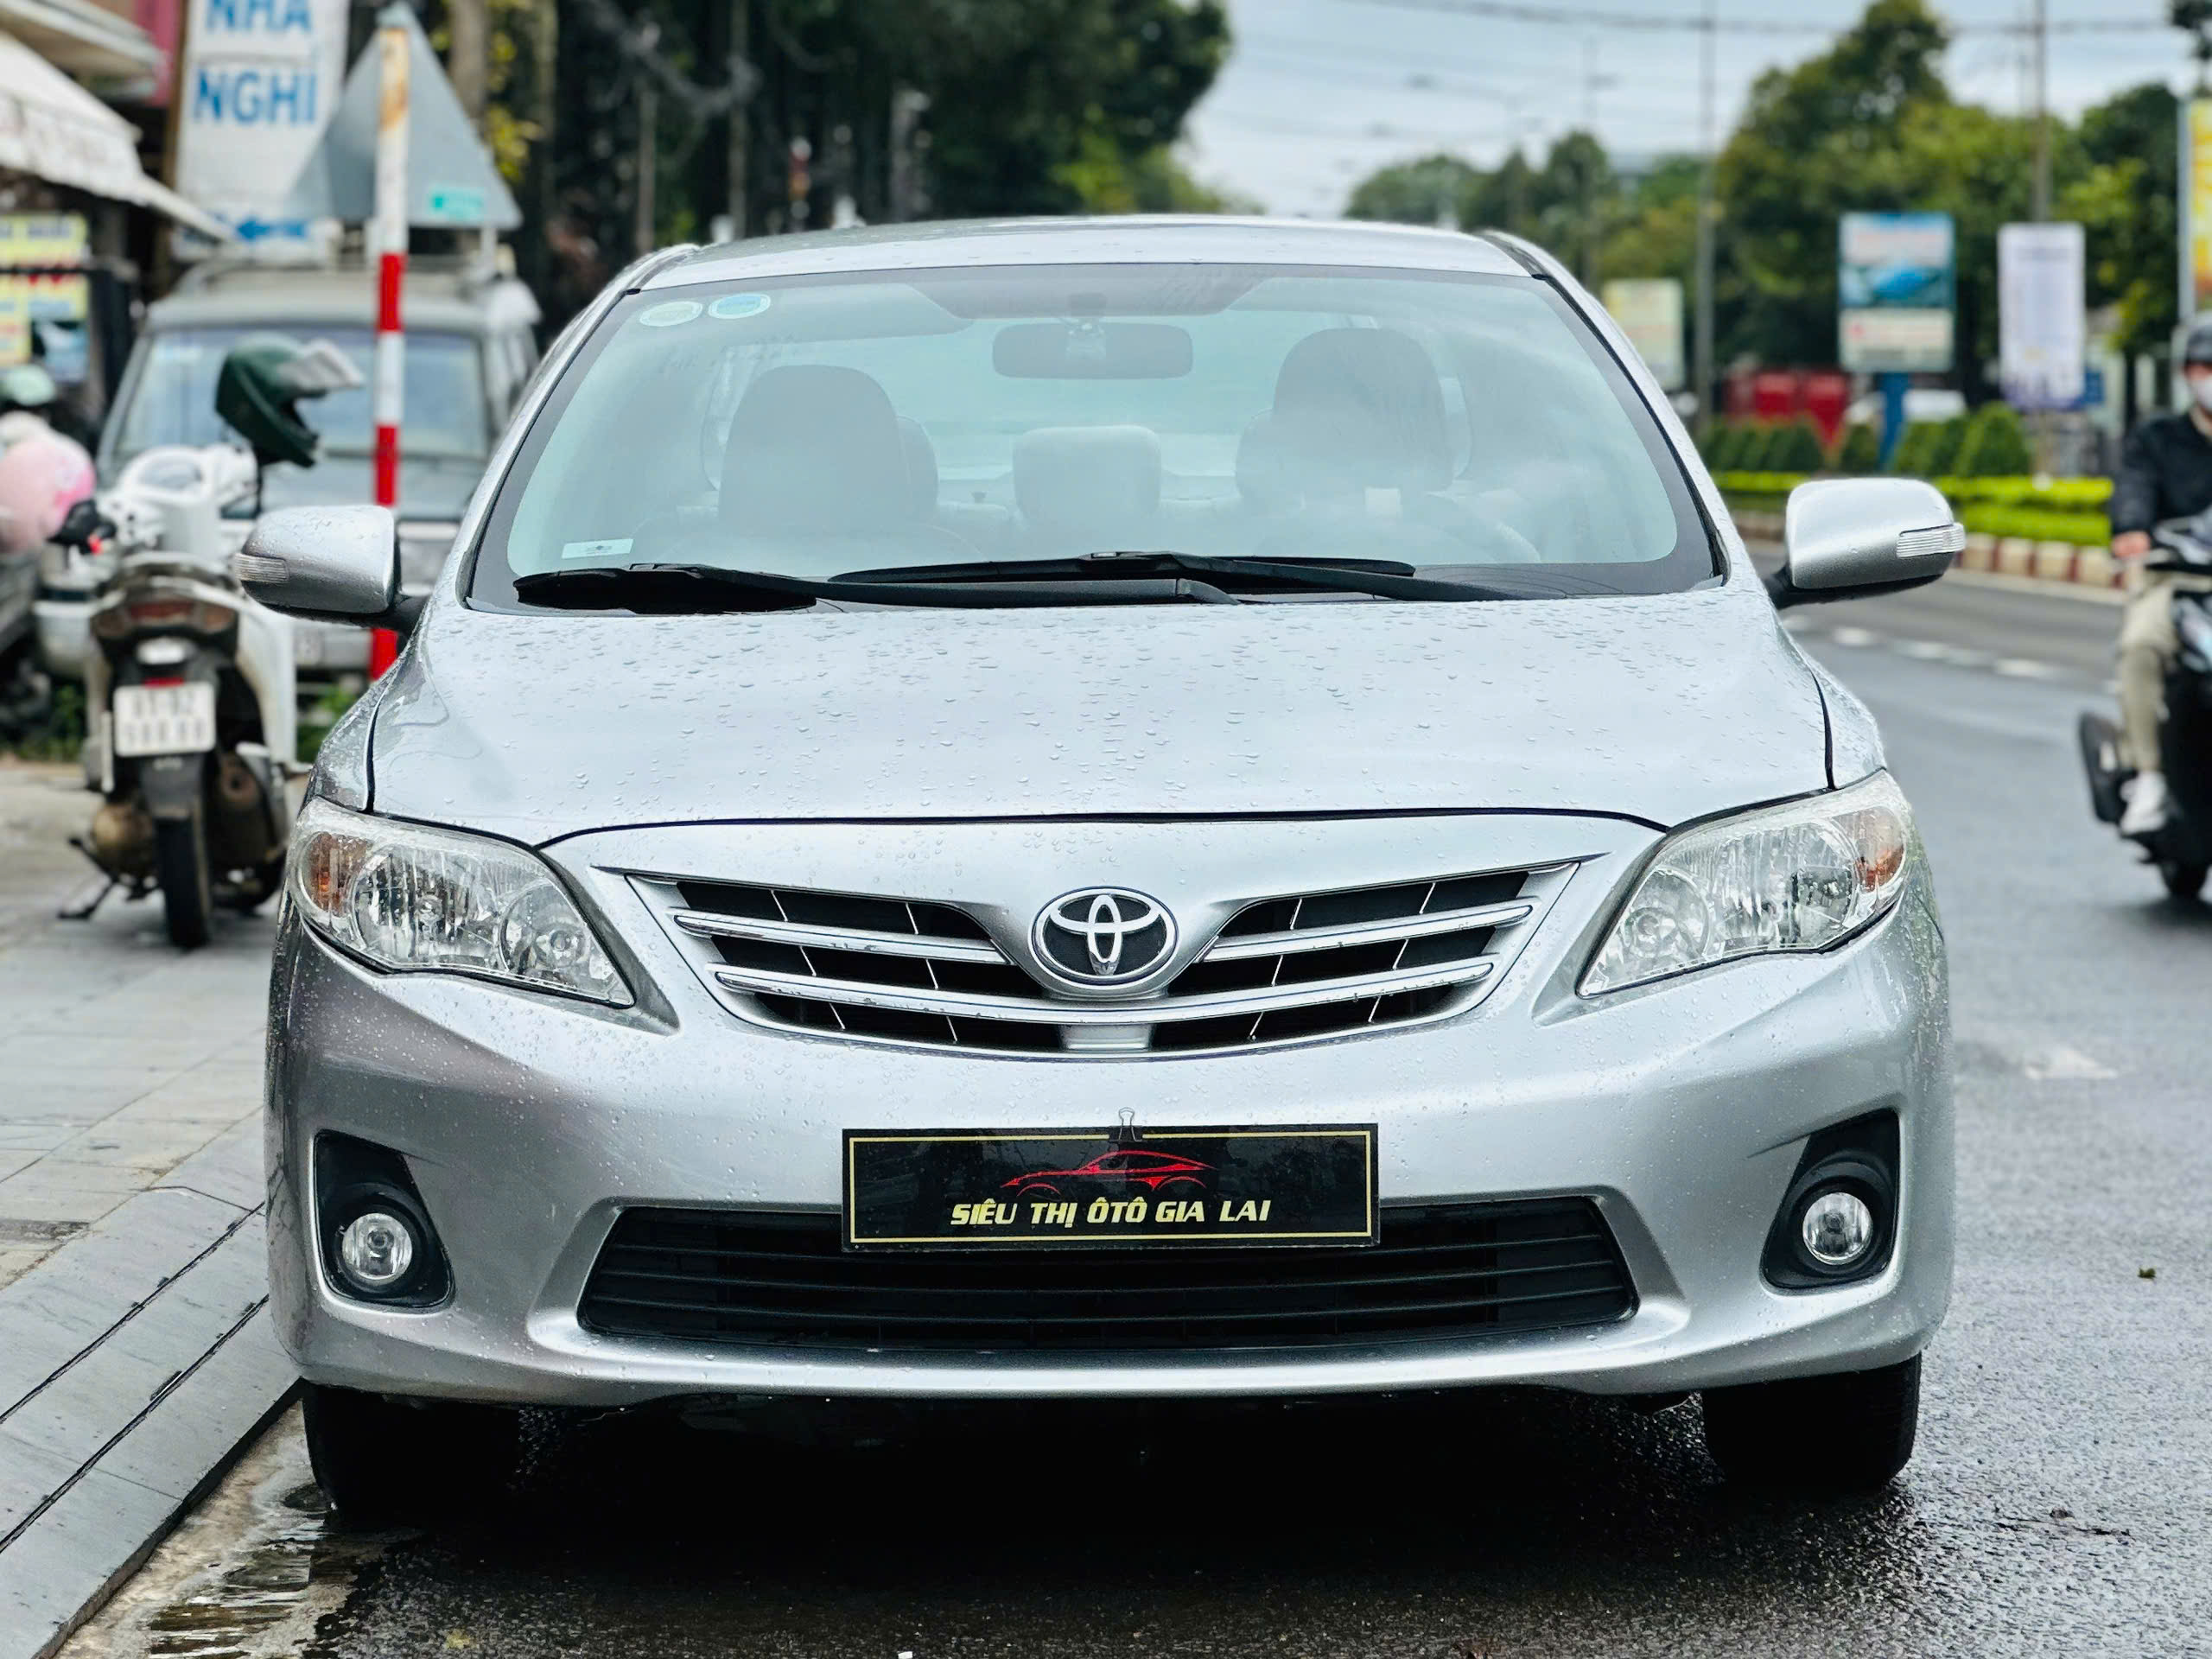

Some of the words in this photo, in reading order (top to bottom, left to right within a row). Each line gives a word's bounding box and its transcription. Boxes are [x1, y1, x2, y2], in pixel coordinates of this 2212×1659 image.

[950, 1198, 1018, 1225] SIÊU
[1030, 1202, 1078, 1229] THỊ
[1086, 1196, 1148, 1224] ÔTÔ
[1154, 1200, 1205, 1223] GIA
[1218, 1199, 1272, 1222] LAI
